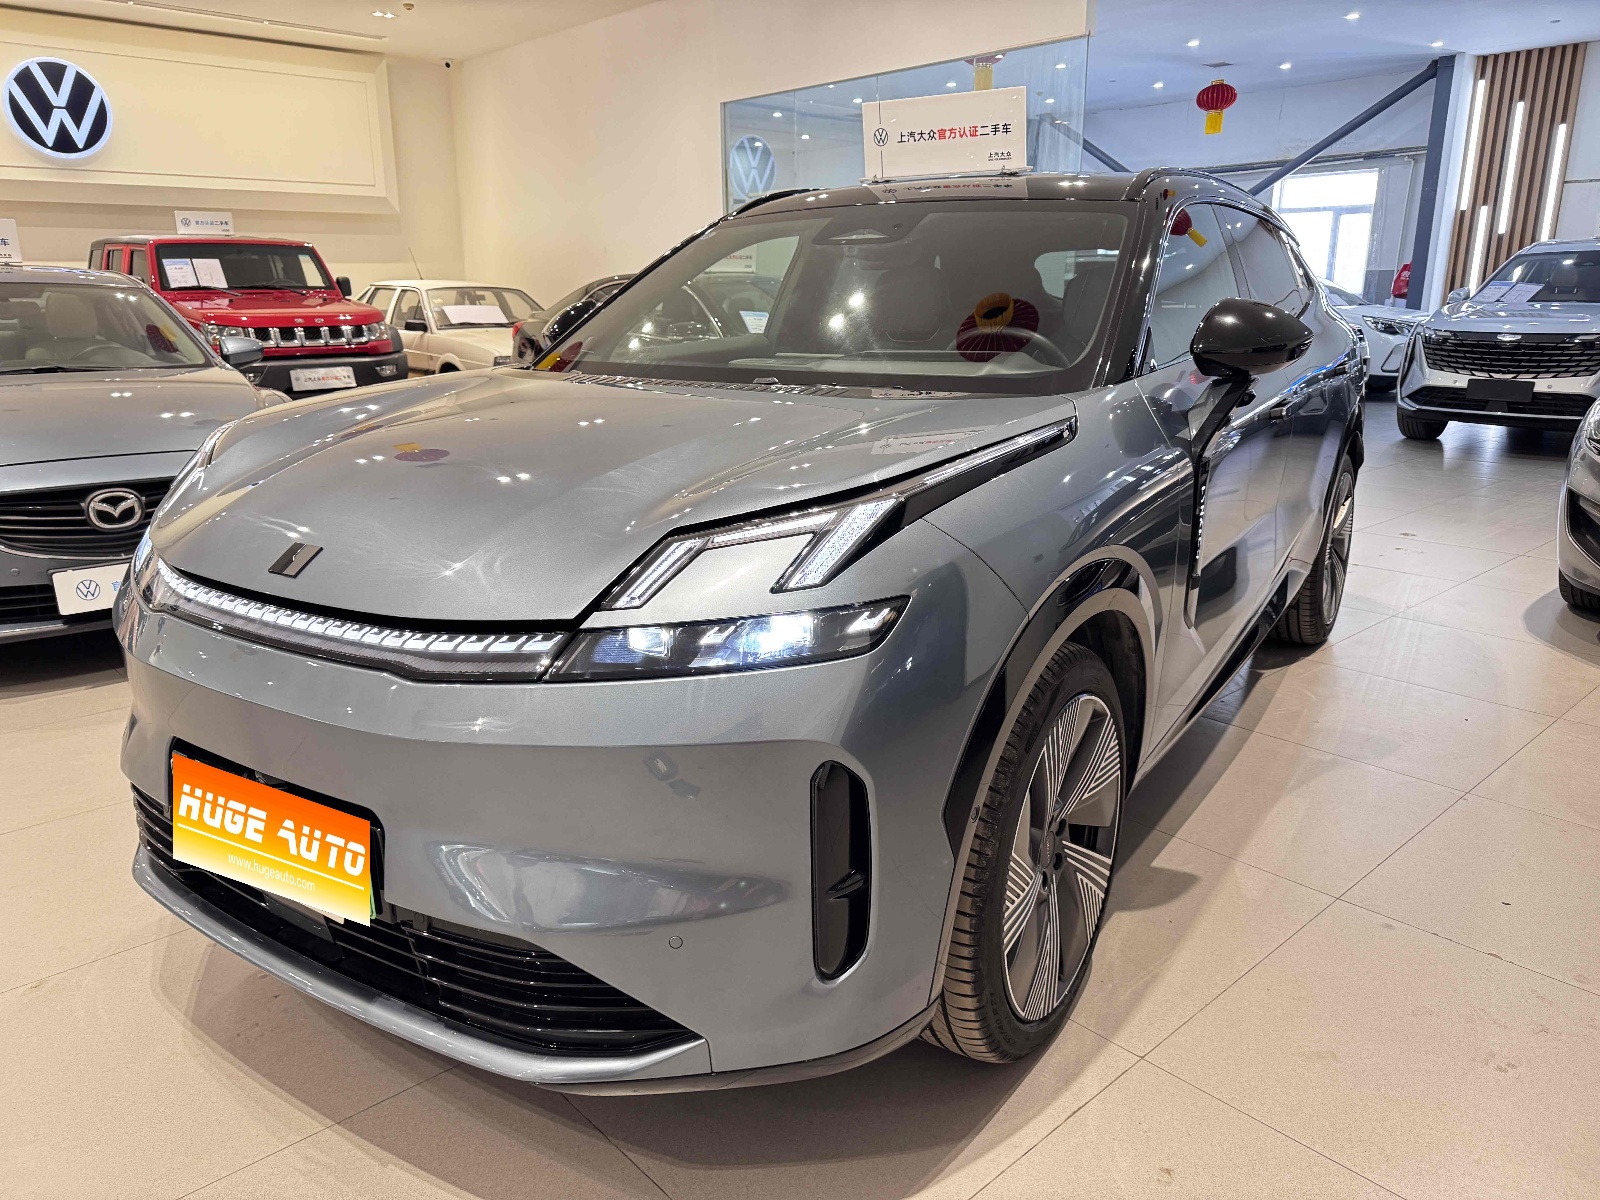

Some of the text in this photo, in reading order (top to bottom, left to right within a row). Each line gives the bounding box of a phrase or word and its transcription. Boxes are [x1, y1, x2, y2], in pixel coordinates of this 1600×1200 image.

[897, 122, 1012, 144] 上汽大众官方认证二手车
